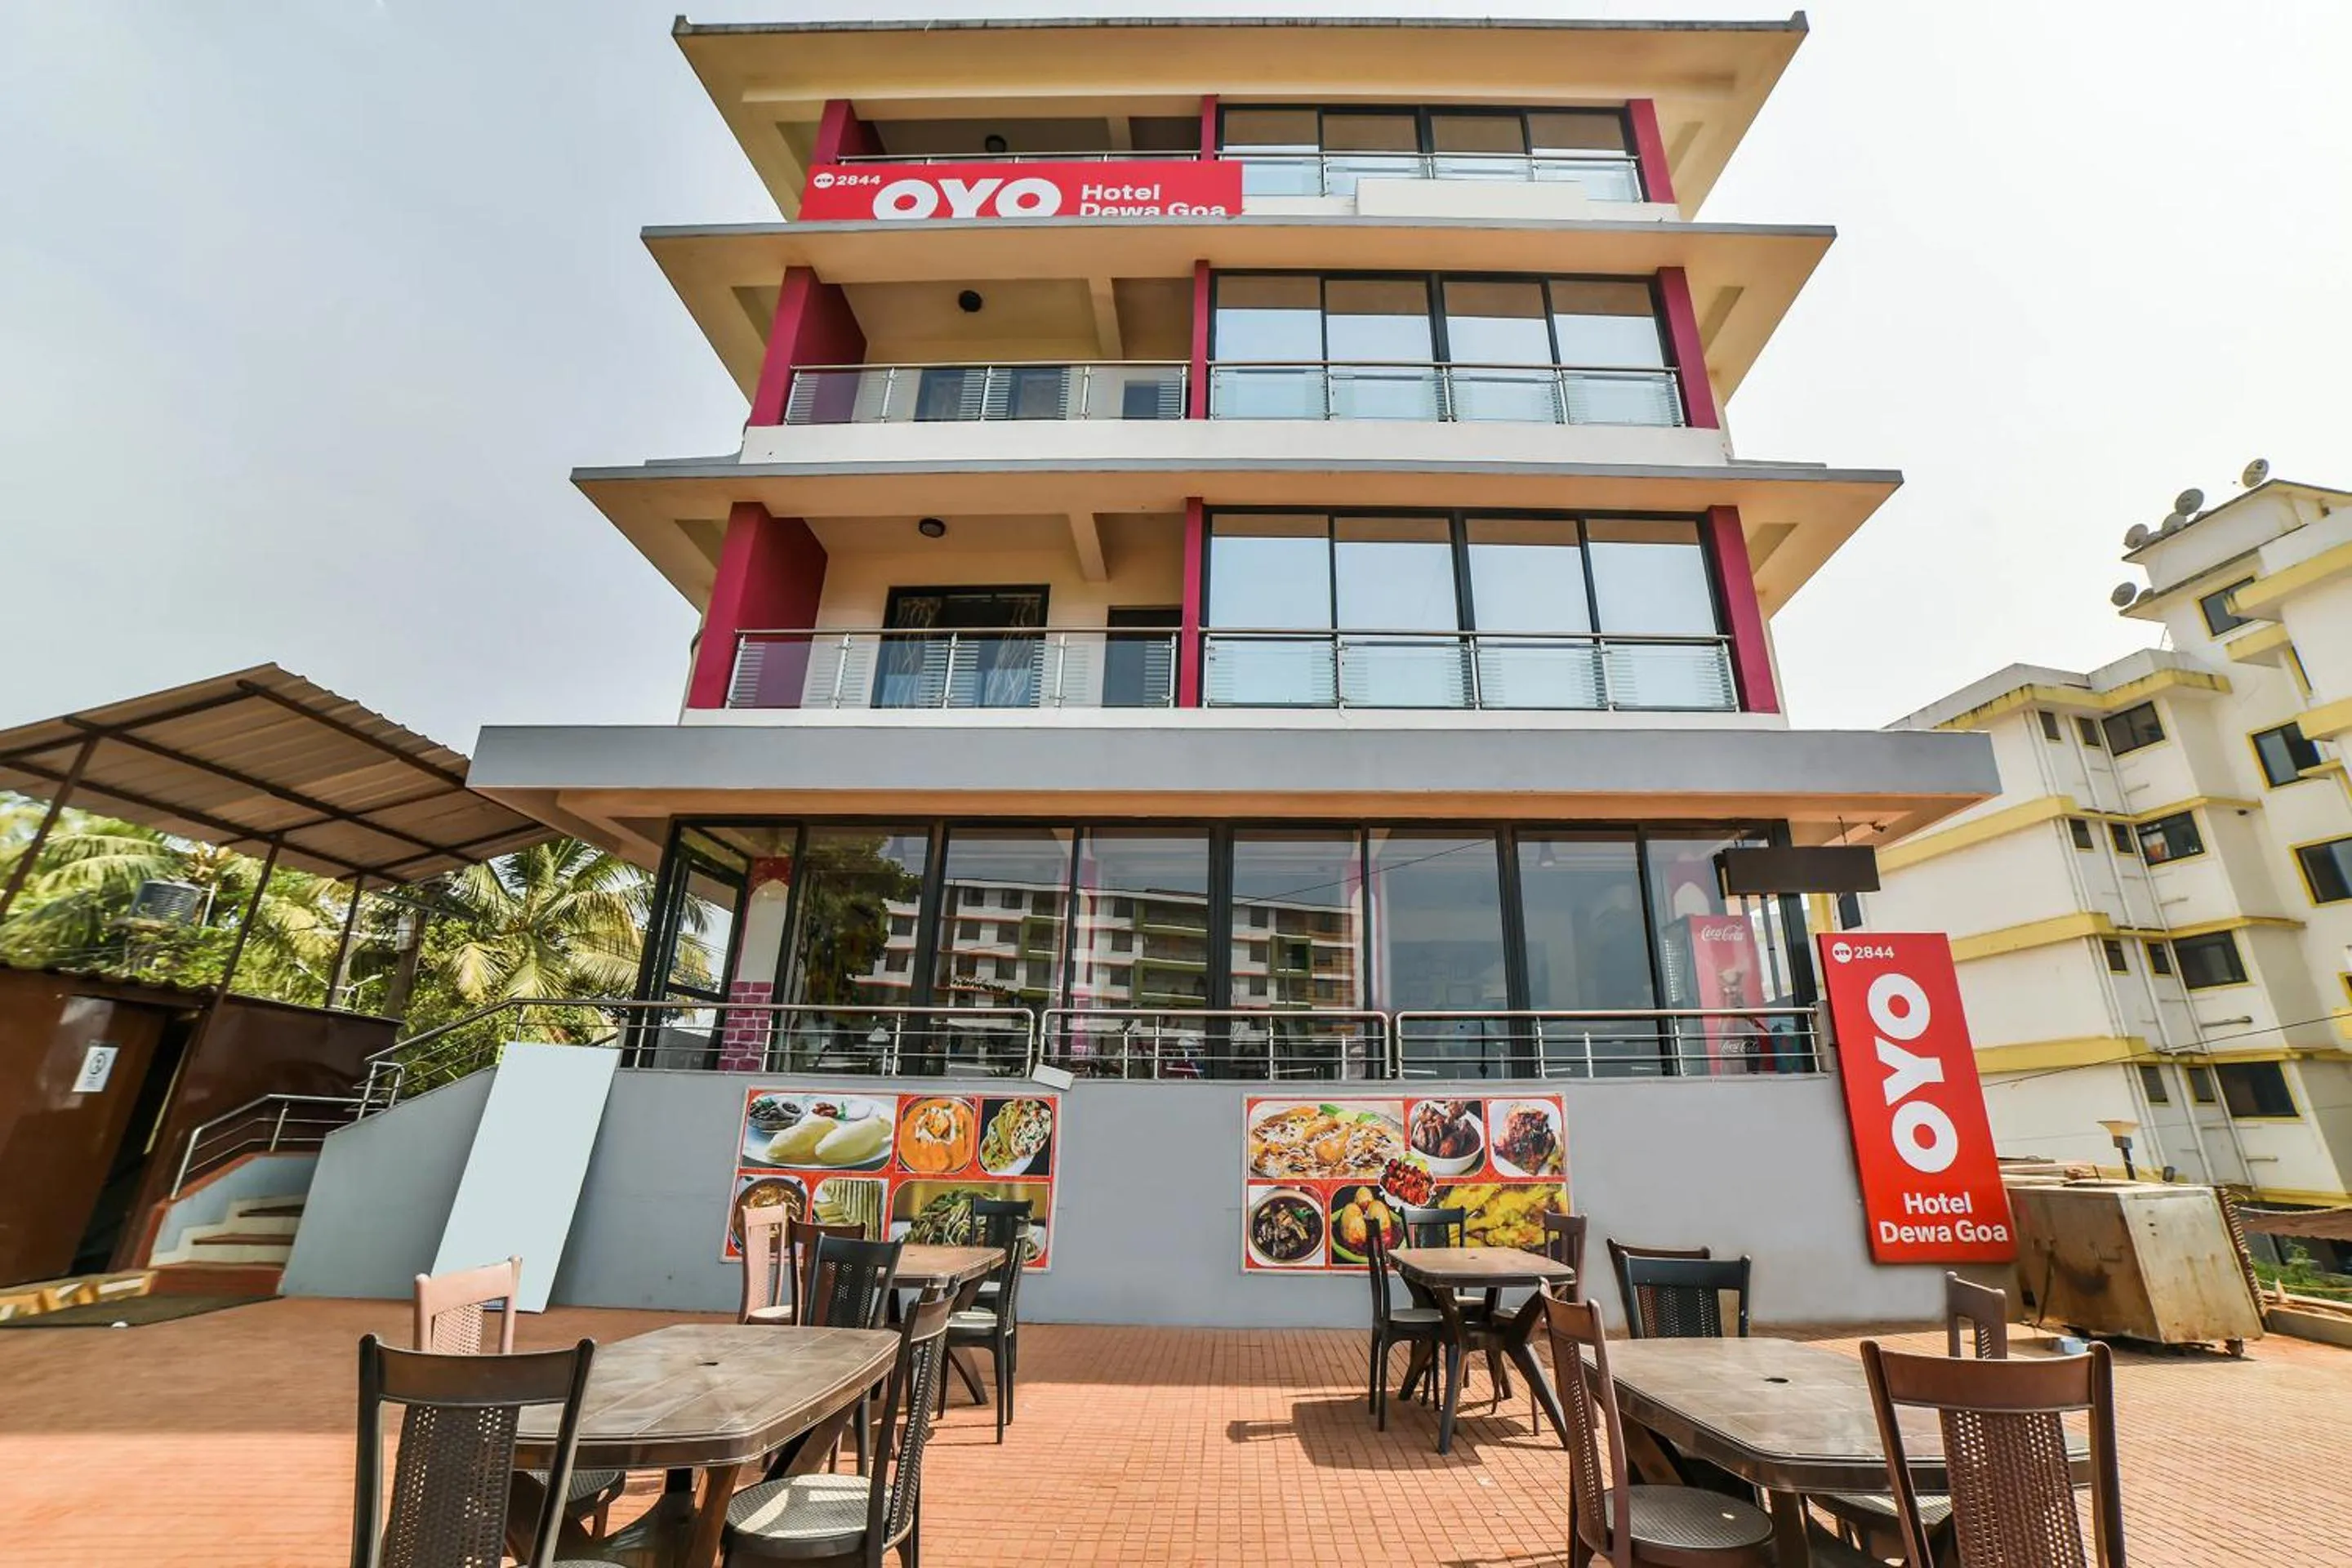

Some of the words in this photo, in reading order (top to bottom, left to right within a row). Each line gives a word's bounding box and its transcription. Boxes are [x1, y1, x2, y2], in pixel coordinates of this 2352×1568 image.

[835, 175, 881, 185] 2844
[872, 177, 1062, 220] OYO
[1081, 184, 1160, 201] Hotel
[1080, 203, 1160, 216] Dewa
[1167, 202, 1226, 216] Goa
[1854, 946, 1895, 959] 2844
[1867, 973, 1958, 1173] OYO
[1903, 1192, 1973, 1214] Hotel
[1879, 1220, 1953, 1243] Dewa
[1955, 1219, 2008, 1242] Goa
